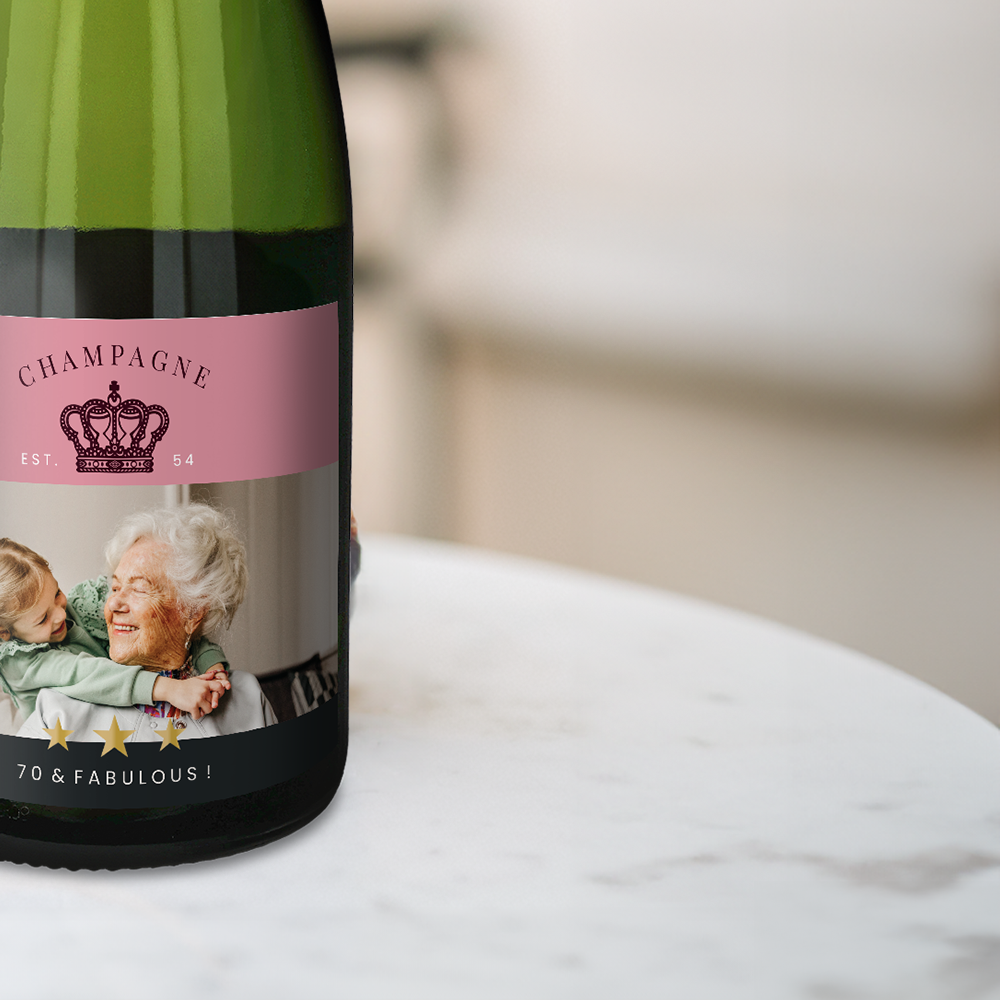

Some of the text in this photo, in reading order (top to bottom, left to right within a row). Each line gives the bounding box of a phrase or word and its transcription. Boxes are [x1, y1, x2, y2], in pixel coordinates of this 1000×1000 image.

[18, 344, 211, 389] CHAMPAGNE
[21, 452, 58, 467] EST.
[173, 453, 194, 467] 54
[17, 763, 42, 781] 70
[51, 767, 65, 784] &
[74, 766, 197, 786] FABULOUS
